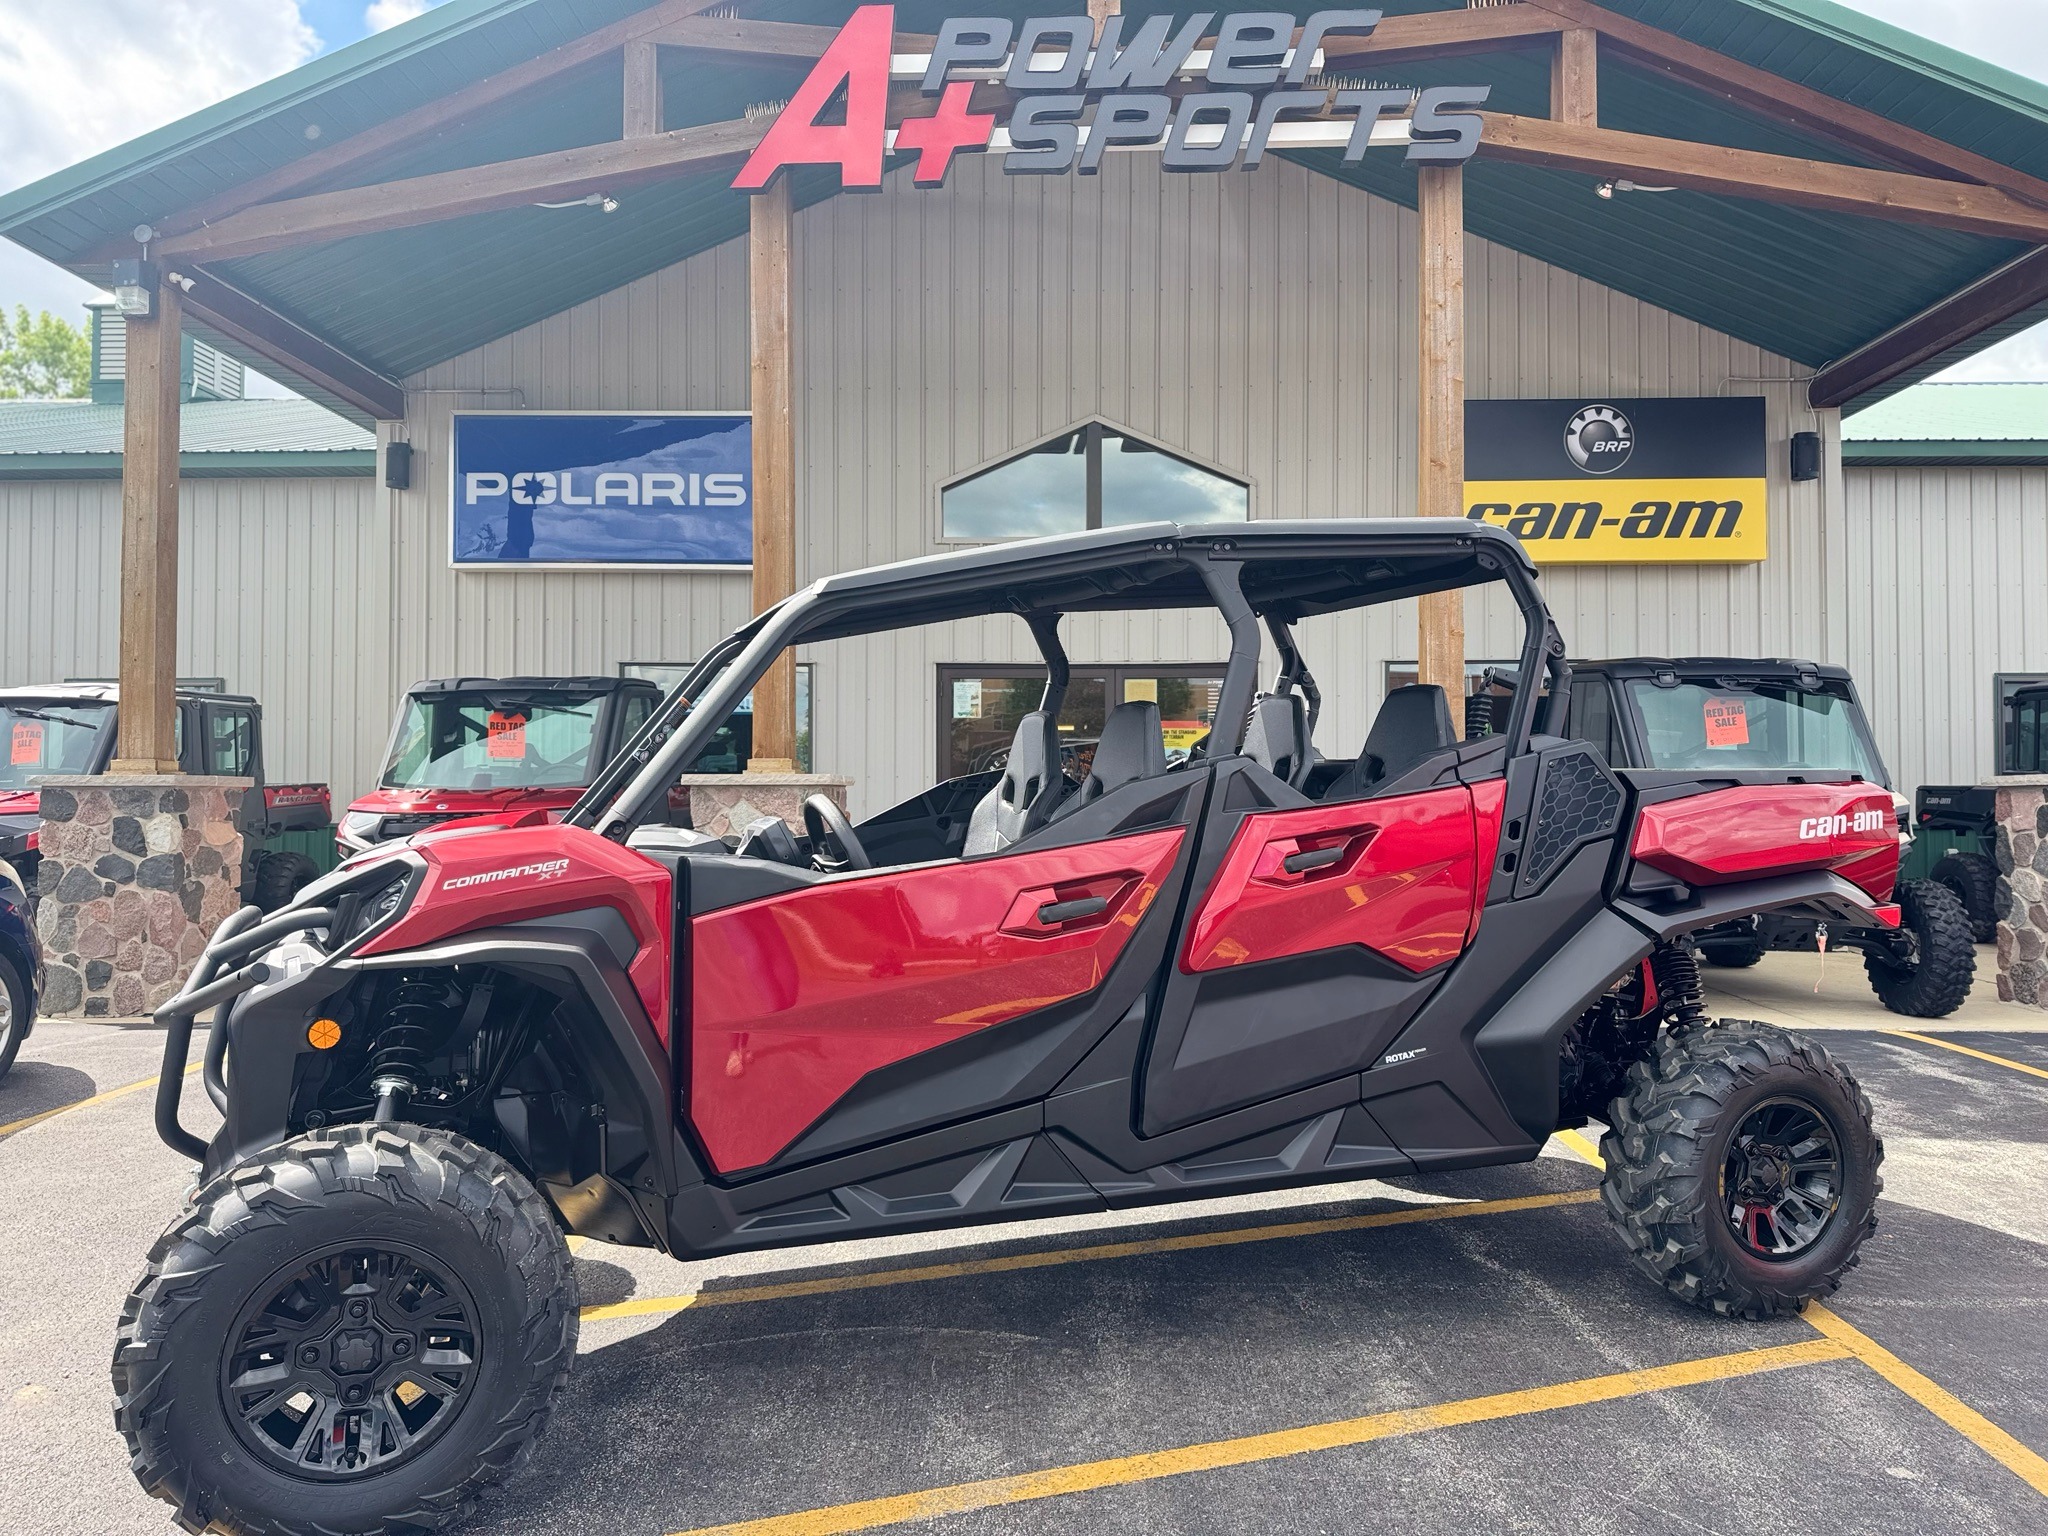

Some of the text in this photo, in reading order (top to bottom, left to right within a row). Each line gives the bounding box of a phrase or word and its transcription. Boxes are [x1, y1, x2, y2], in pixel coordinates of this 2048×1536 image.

[1592, 440, 1631, 453] BRP
[466, 472, 748, 507] POLARIS
[1706, 706, 1744, 718] RED TAG
[490, 722, 525, 731] RED TAG
[1715, 717, 1737, 727] SALE
[497, 732, 517, 740] SALE
[17, 739, 32, 747] SALE
[277, 795, 312, 804] RANGER
[1926, 797, 1952, 805] can-am
[1800, 809, 1884, 840] can-am
[442, 858, 570, 891] COMMANDER
[537, 868, 568, 881] XT
[1385, 1050, 1416, 1064] ROTAX
